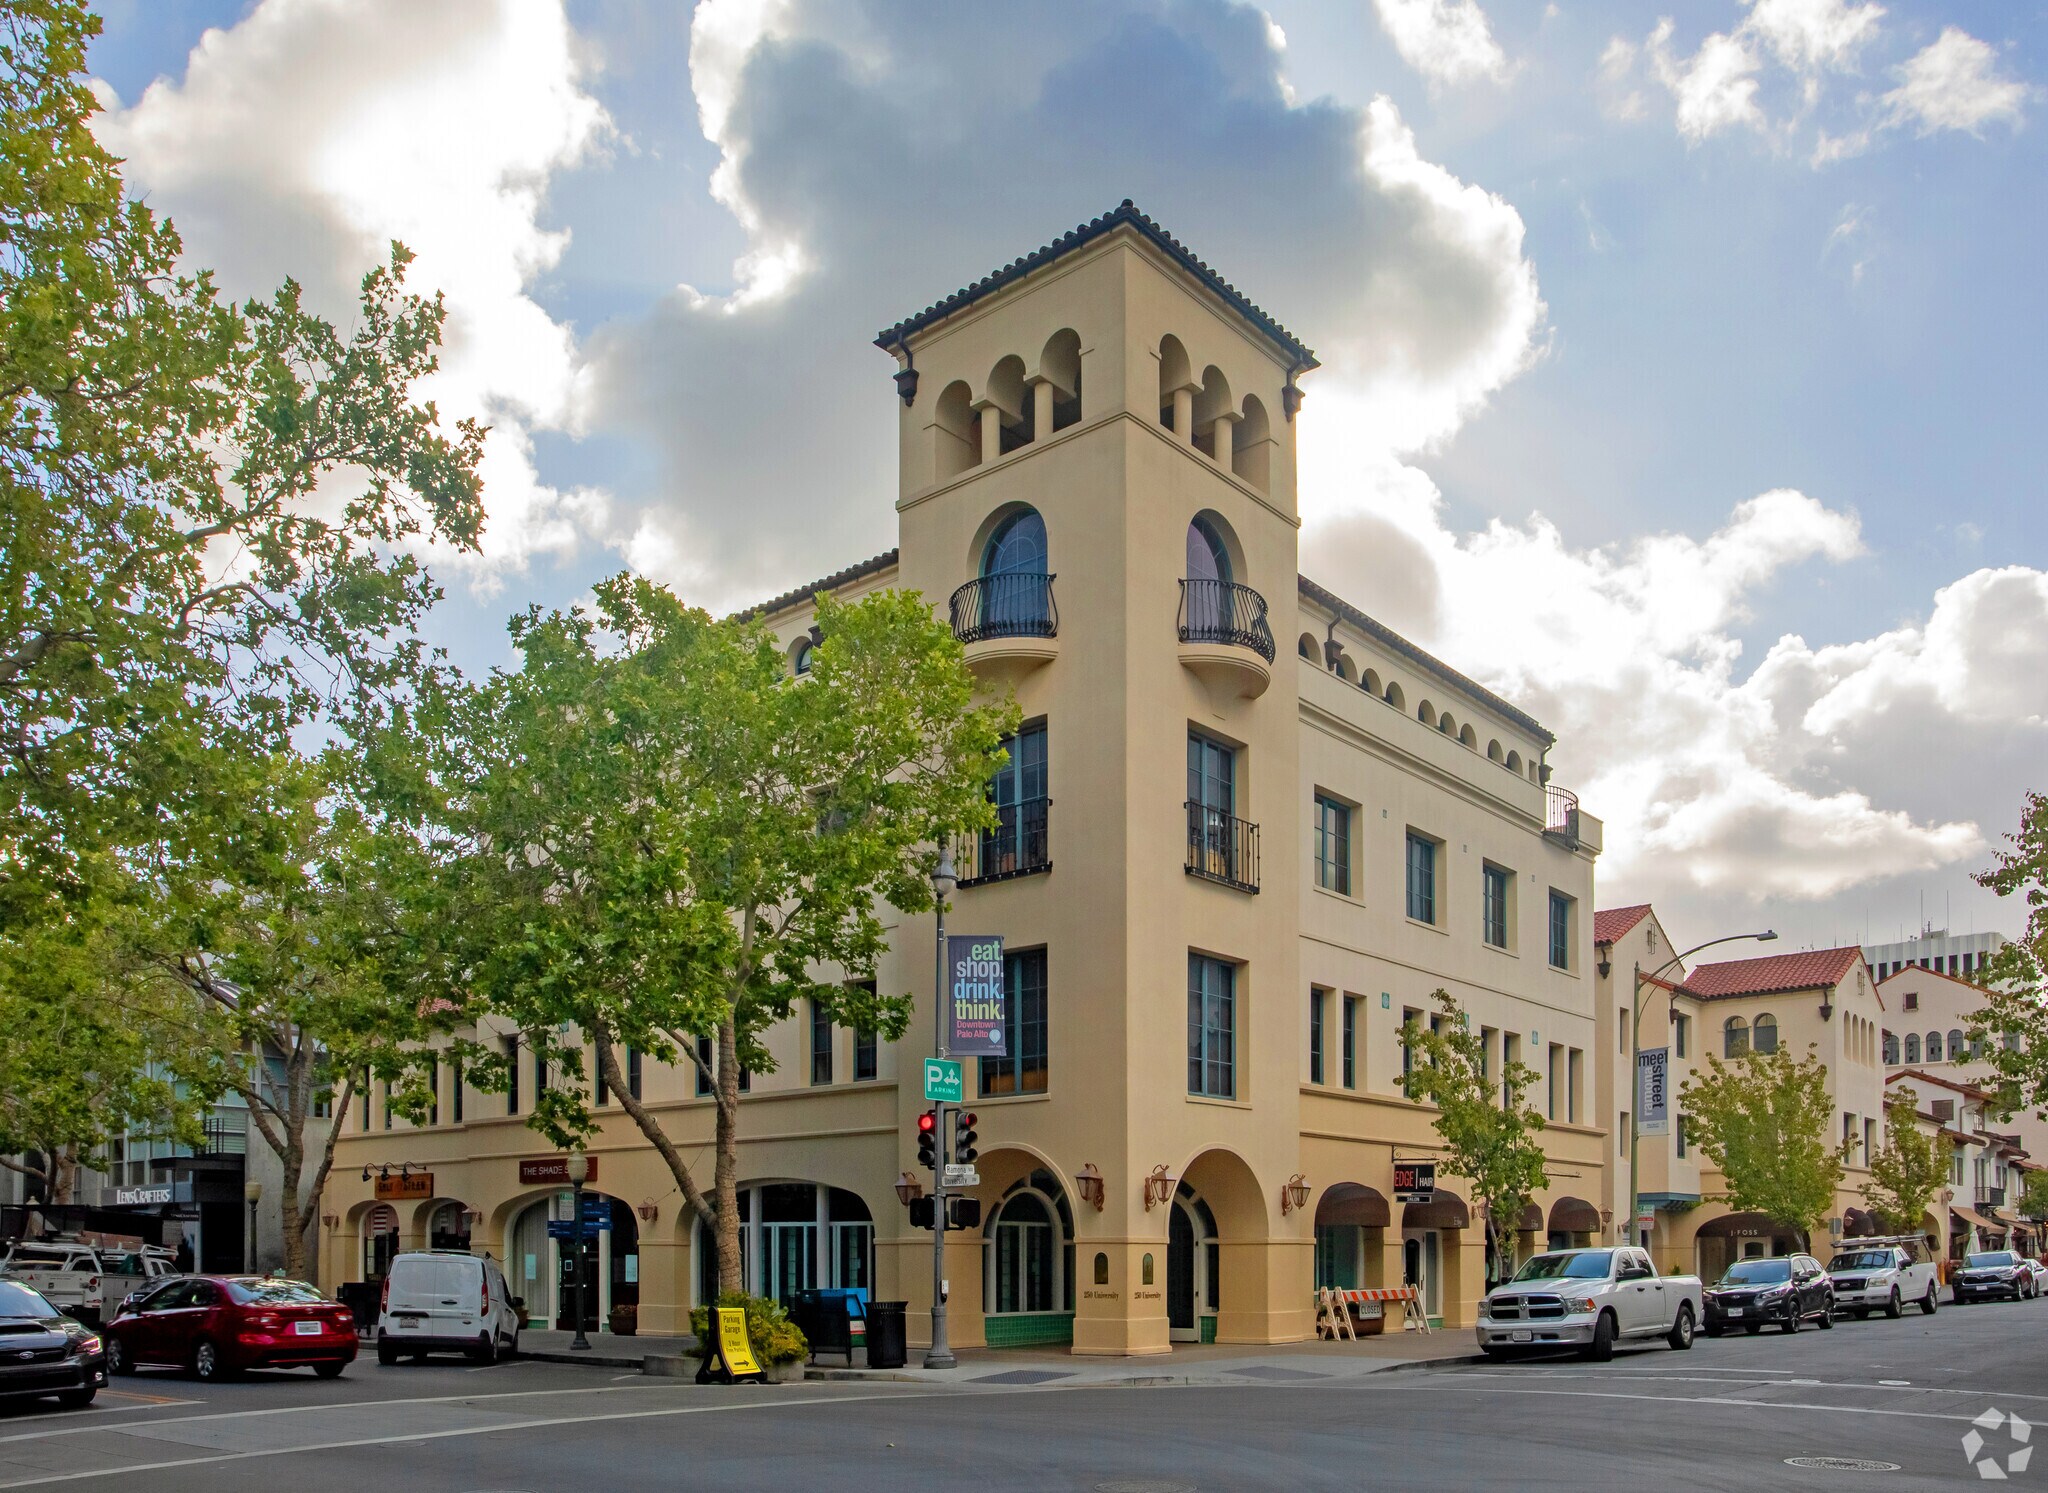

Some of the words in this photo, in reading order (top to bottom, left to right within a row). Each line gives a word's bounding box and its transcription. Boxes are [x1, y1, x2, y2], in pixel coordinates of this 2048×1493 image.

[972, 941, 1003, 960] eat.
[956, 957, 1004, 977] shop.
[954, 978, 1004, 999] drink.
[955, 999, 1005, 1019] think.
[956, 1021, 996, 1029] Downtown
[956, 1030, 973, 1038] Palo
[974, 1030, 989, 1038] Alto
[1638, 1050, 1668, 1067] meet
[1644, 1066, 1653, 1116] ramona
[1652, 1065, 1664, 1109] street
[523, 1167, 537, 1176] THE
[538, 1166, 563, 1175] SHADE
[946, 1165, 967, 1174] Ramona
[1394, 1171, 1414, 1187] EDGE
[1419, 1177, 1434, 1187] HAIR
[1094, 1291, 1119, 1301] University
[1142, 1291, 1161, 1300] University
[1361, 1305, 1380, 1314] CLOSED
[723, 1315, 741, 1324] Parking
[724, 1325, 741, 1334] Garage
